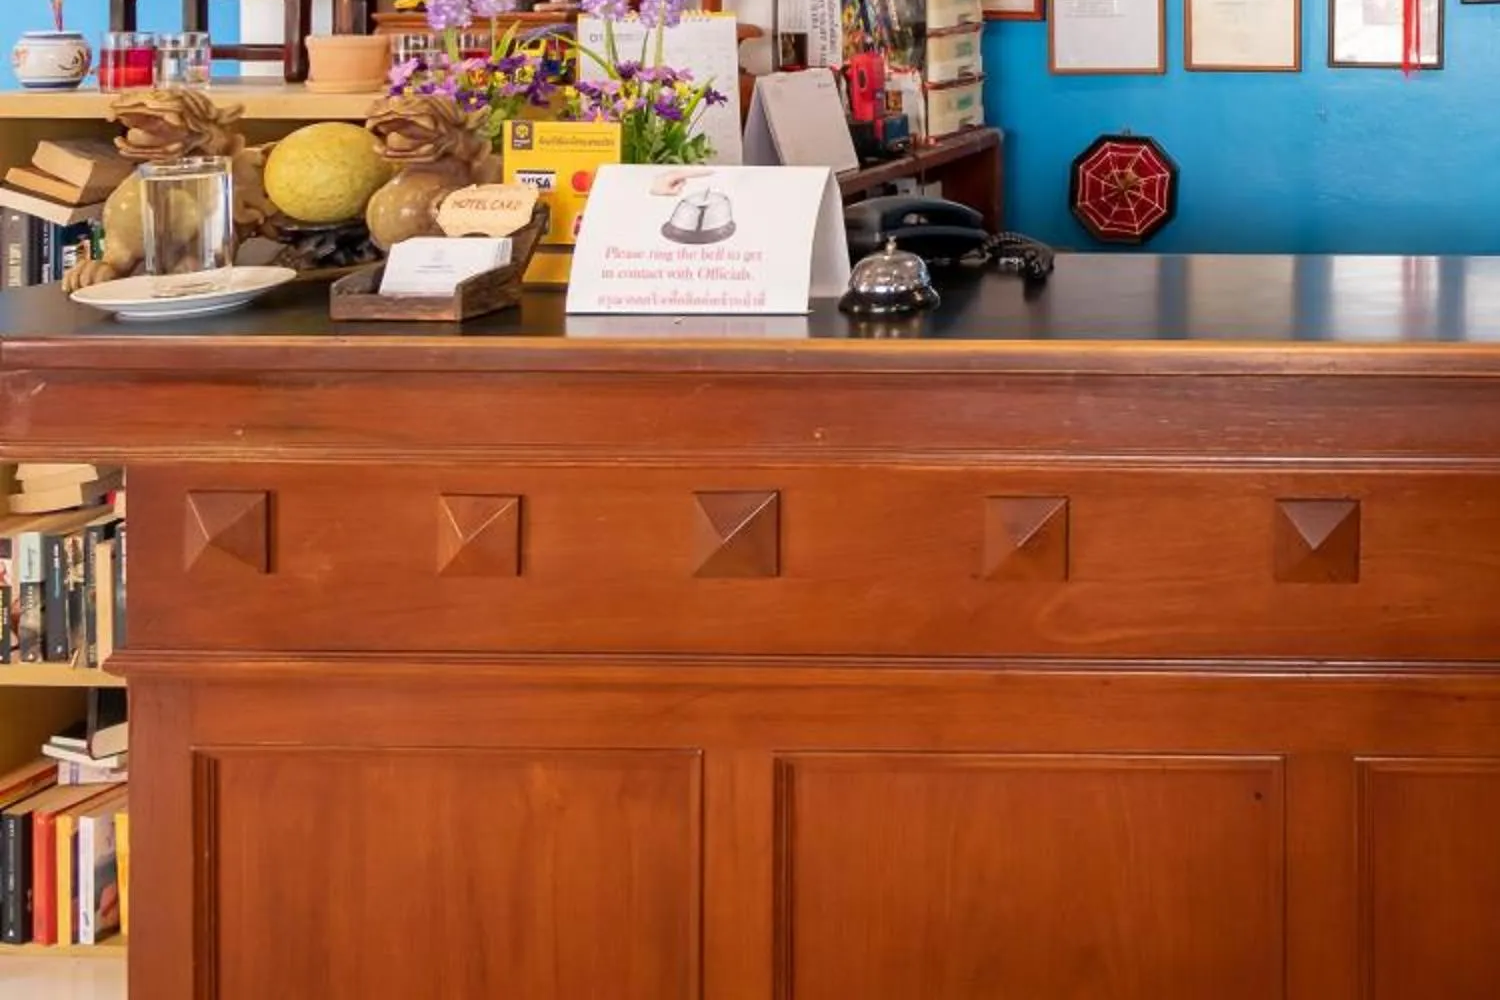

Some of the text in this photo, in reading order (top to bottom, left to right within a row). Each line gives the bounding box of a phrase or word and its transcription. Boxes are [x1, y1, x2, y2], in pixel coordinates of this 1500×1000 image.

[451, 199, 487, 211] HOTEL
[605, 246, 644, 259] Please
[650, 249, 672, 262] ring
[677, 247, 696, 260] the
[701, 247, 725, 260] bell
[743, 251, 762, 263] get
[617, 268, 663, 279] contact
[667, 267, 693, 279] with
